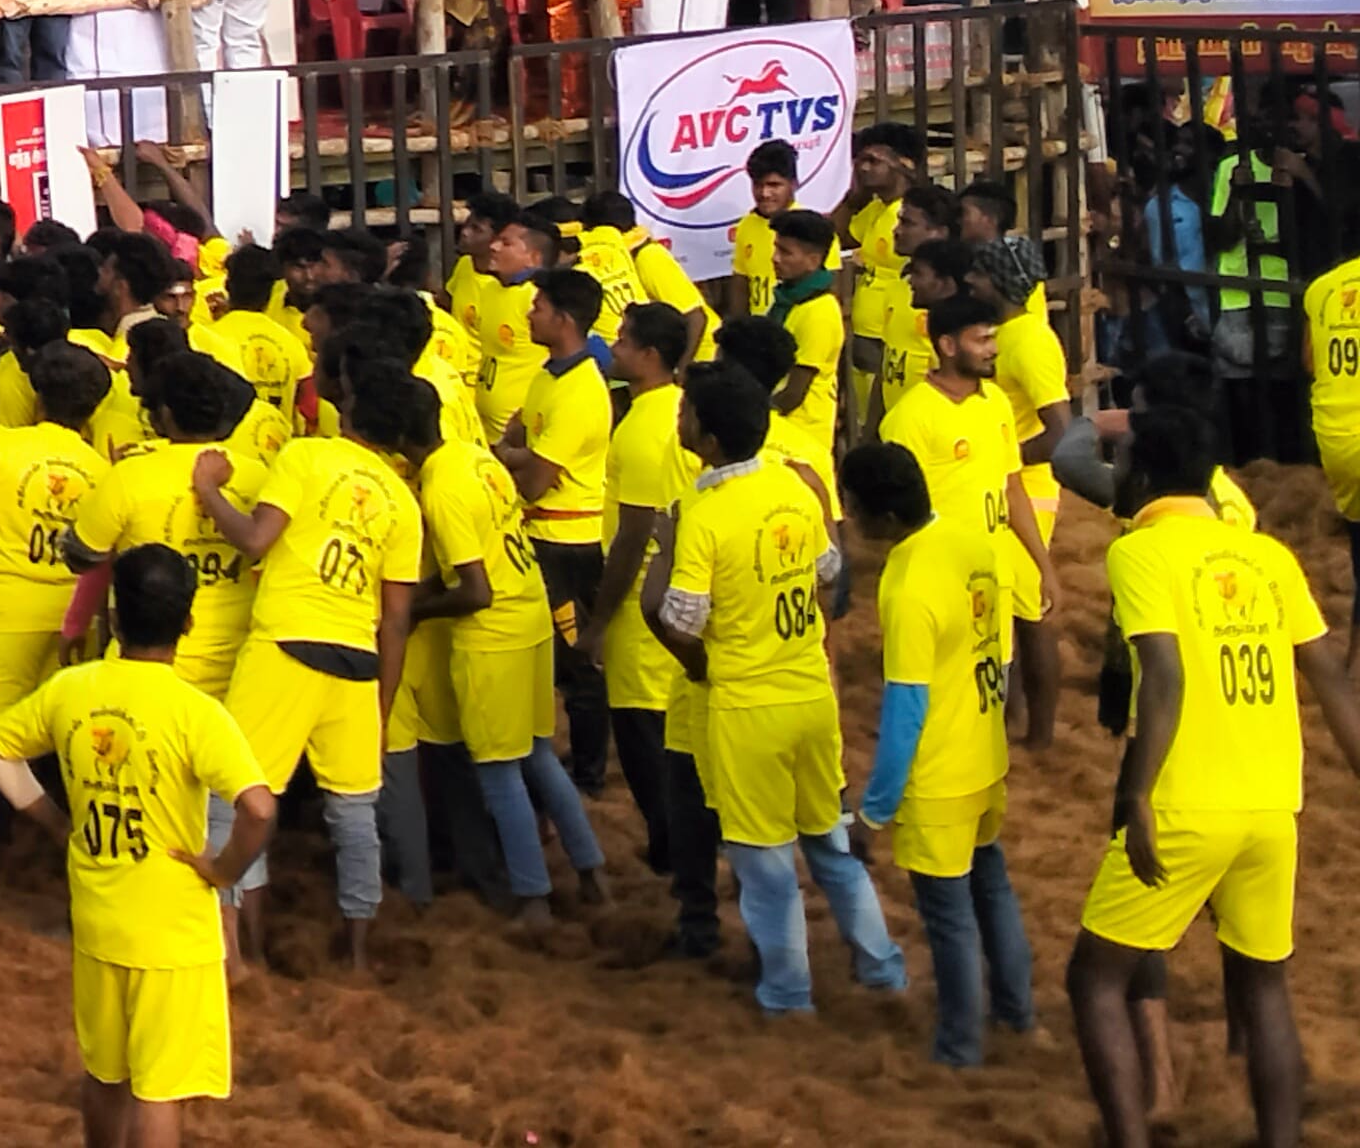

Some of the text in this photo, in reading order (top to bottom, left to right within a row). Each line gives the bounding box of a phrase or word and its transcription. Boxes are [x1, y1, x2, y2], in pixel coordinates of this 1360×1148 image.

[671, 94, 839, 153] AVC TVS
[1328, 337, 1360, 377] 09
[28, 523, 66, 566] 01
[775, 585, 816, 641] 084
[1220, 643, 1275, 706] 039
[83, 799, 148, 863] 075
